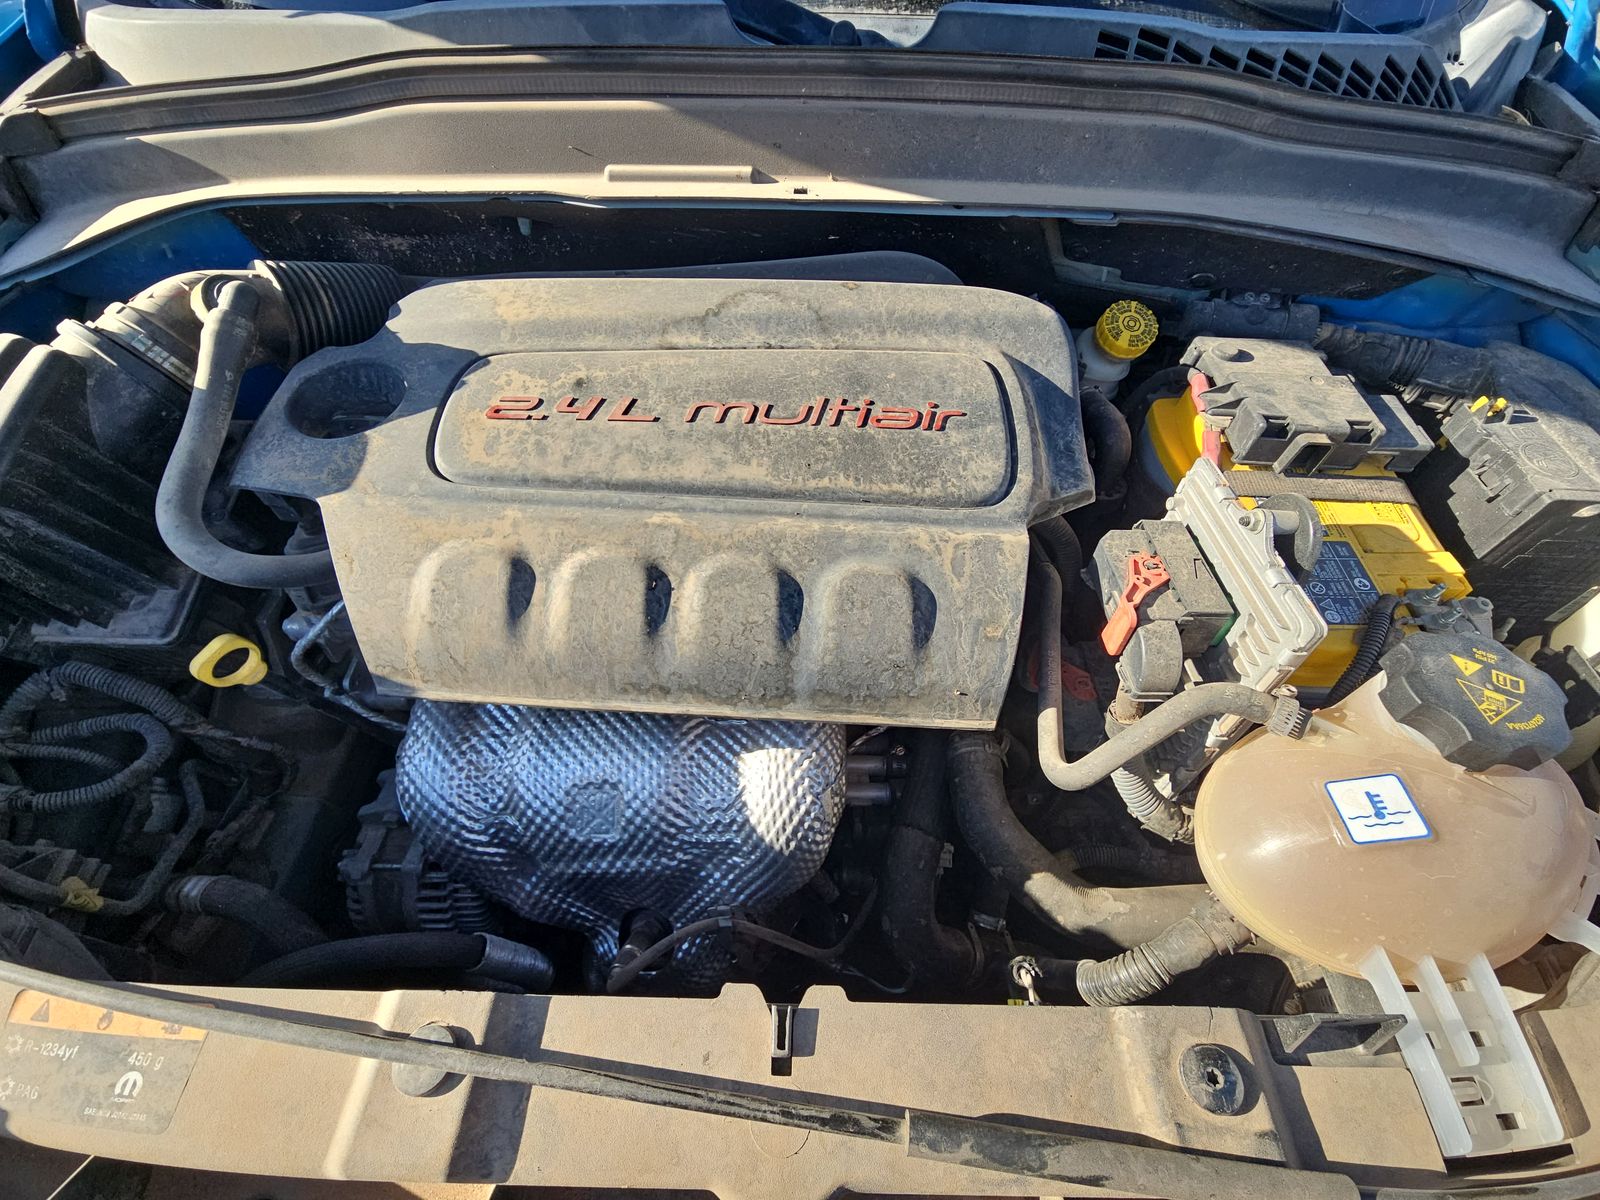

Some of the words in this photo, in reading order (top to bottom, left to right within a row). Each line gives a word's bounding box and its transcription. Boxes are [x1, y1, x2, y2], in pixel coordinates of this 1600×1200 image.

[684, 397, 965, 431] multiair
[24, 1040, 79, 1061] R-1234yf
[128, 1052, 152, 1066] 450
[154, 1056, 164, 1070] g
[15, 1083, 39, 1099] PAG
